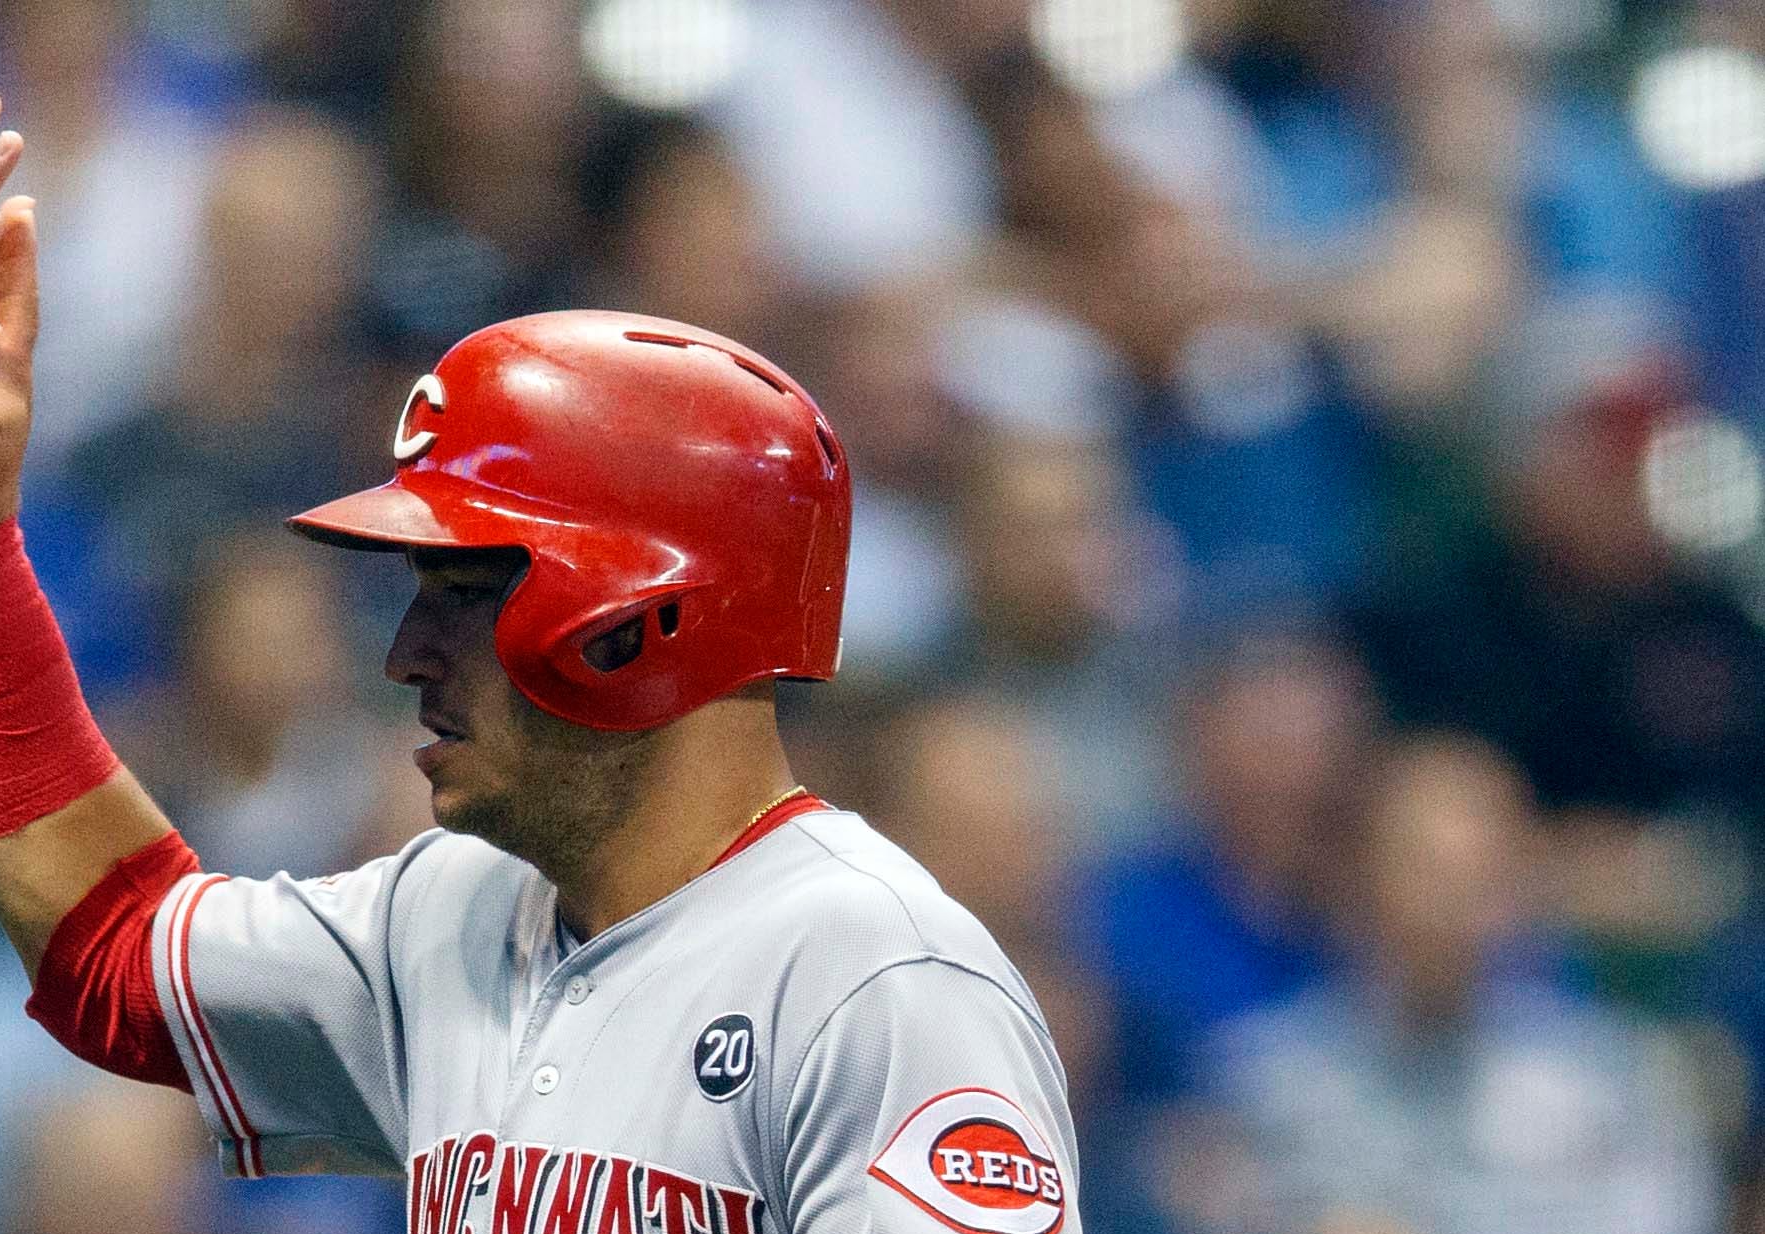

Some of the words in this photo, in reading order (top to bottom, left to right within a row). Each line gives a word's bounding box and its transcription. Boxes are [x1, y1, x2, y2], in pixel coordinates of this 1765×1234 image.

[394, 373, 446, 461] C
[699, 1029, 750, 1077] 20
[936, 1147, 1063, 1204] REDS
